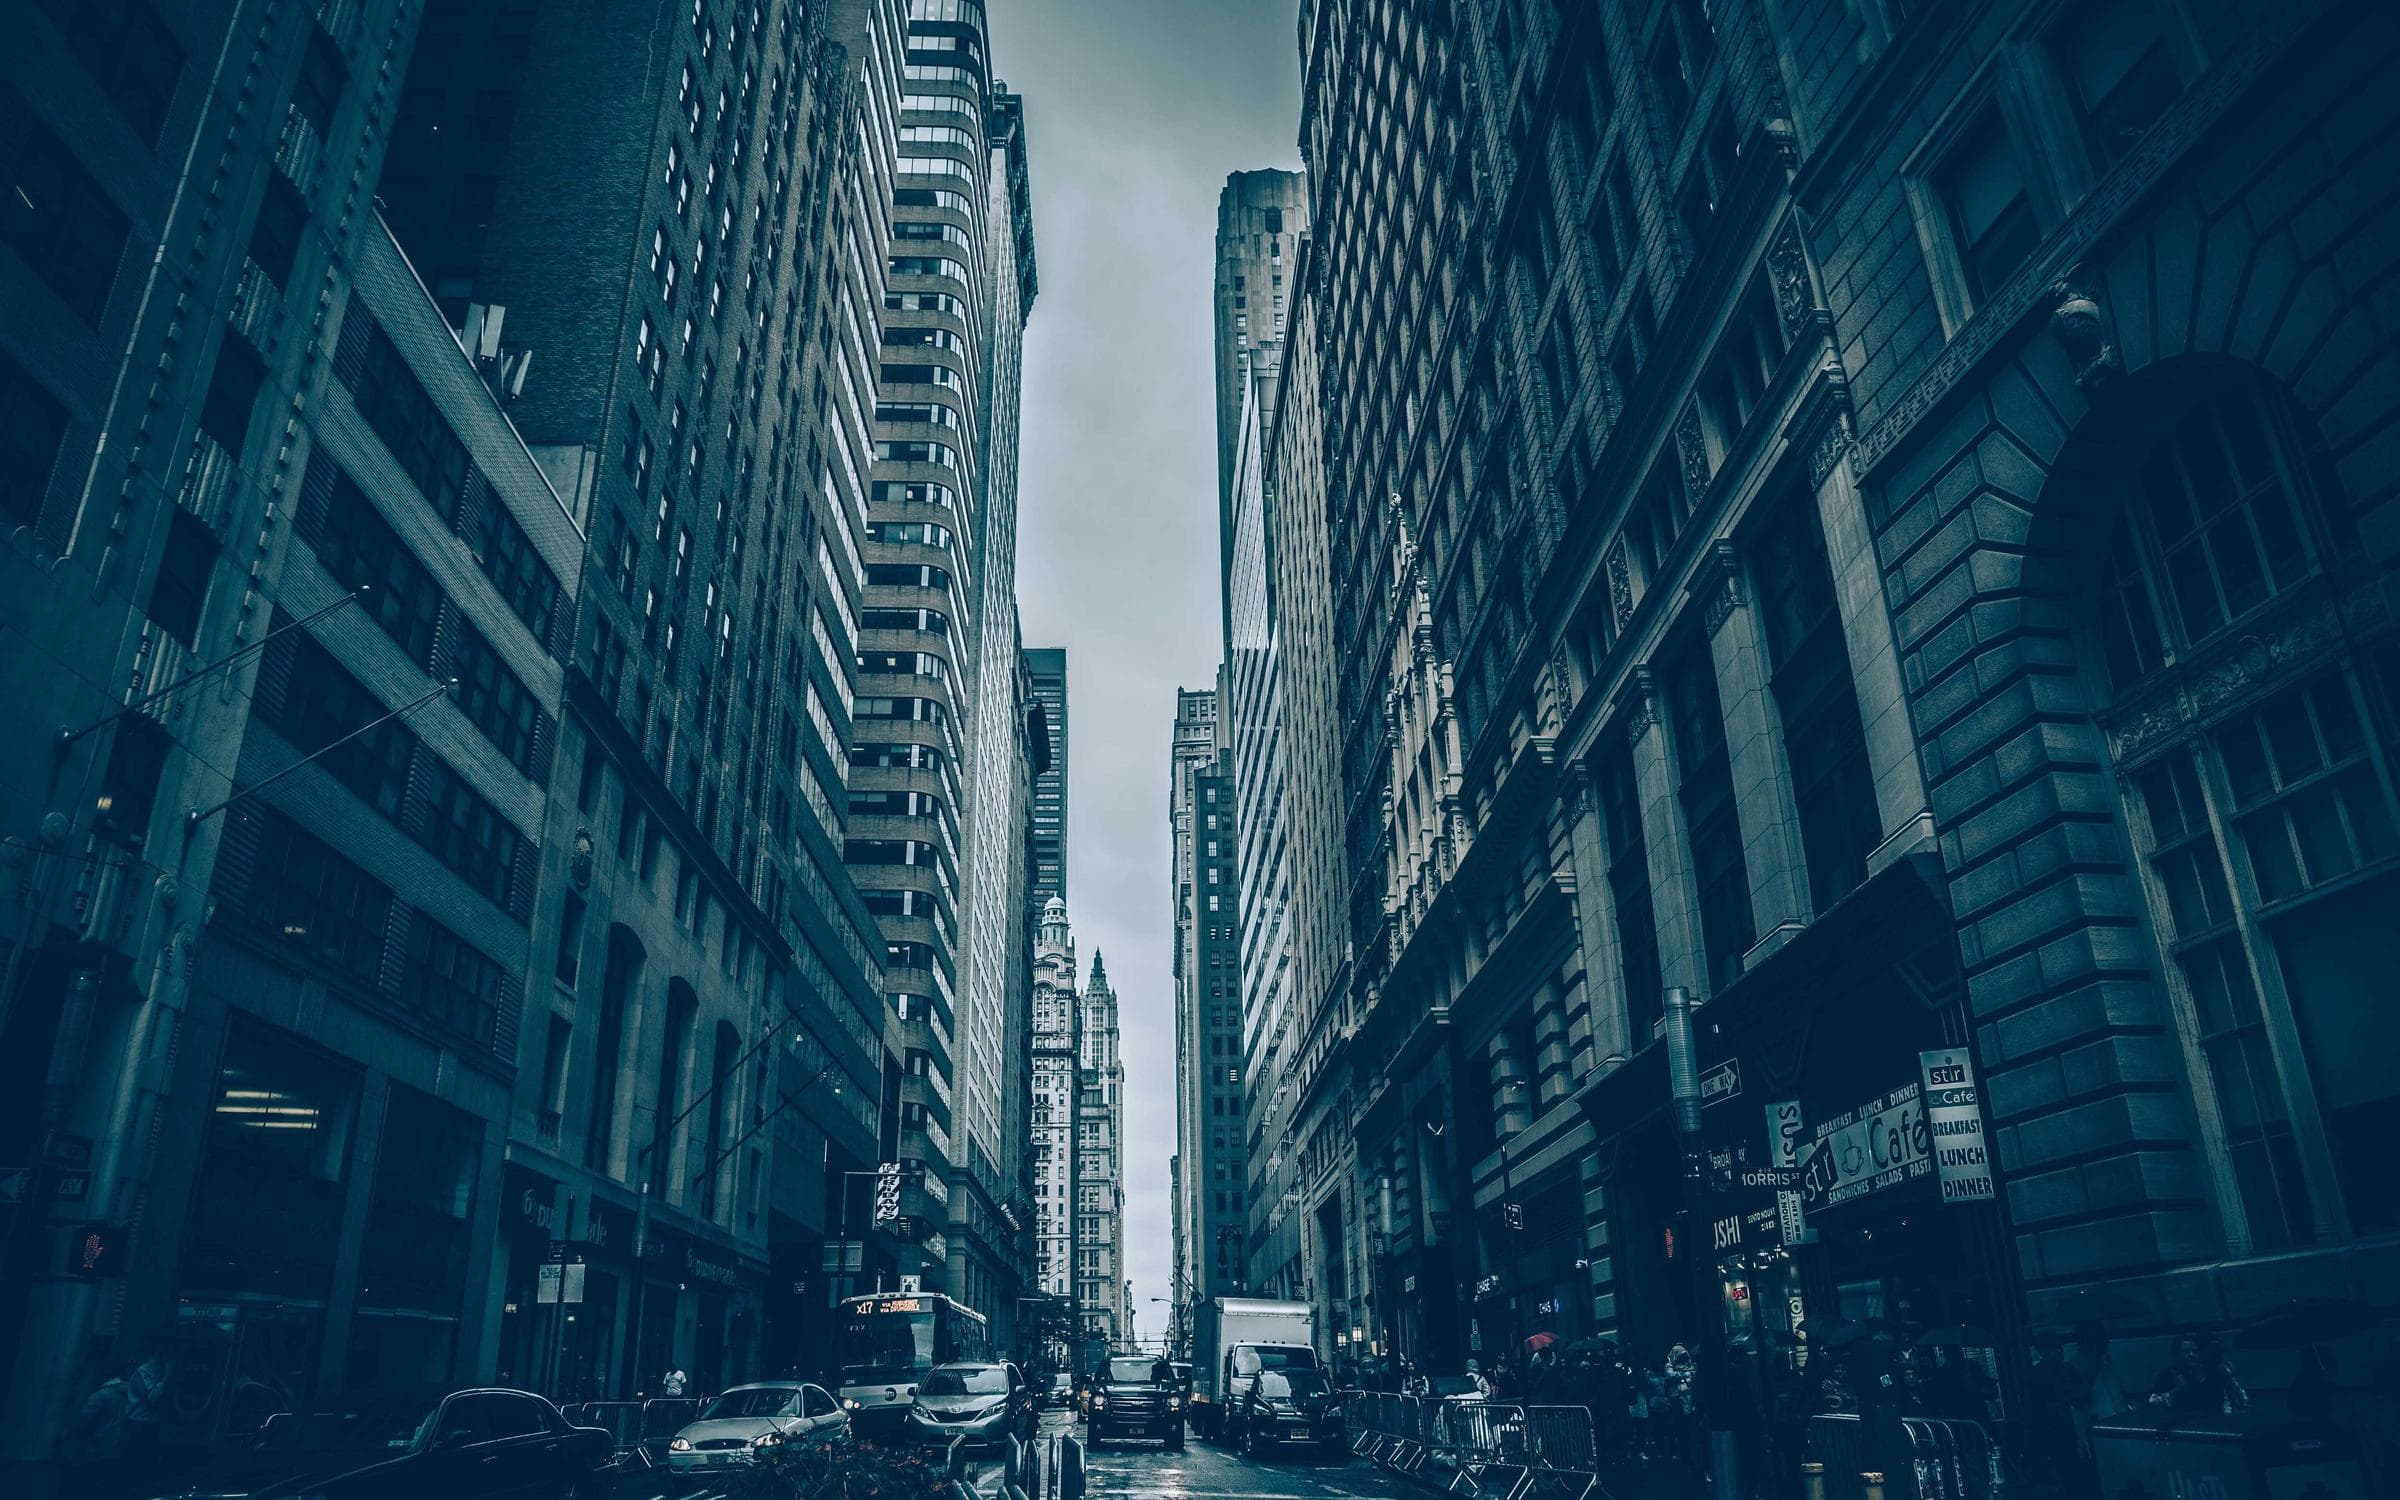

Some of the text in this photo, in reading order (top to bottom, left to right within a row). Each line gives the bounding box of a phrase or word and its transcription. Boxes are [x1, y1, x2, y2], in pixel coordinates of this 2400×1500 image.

[1703, 1072, 1732, 1095] ONE WAY
[1816, 1083, 1919, 1137] BREAKFAST LUNCH DINNER
[1933, 1119, 1980, 1136] BREAKFAST
[1870, 1103, 1928, 1169] Café
[1940, 1148, 1984, 1167] LUNCH
[1828, 1180, 1869, 1204] SANDWICHES
[1875, 1169, 1903, 1189] SALADS
[1944, 1177, 1992, 1198] DINNER
[1714, 1215, 1741, 1250] USHI
[1780, 1202, 1792, 1242] NOUVEAU
